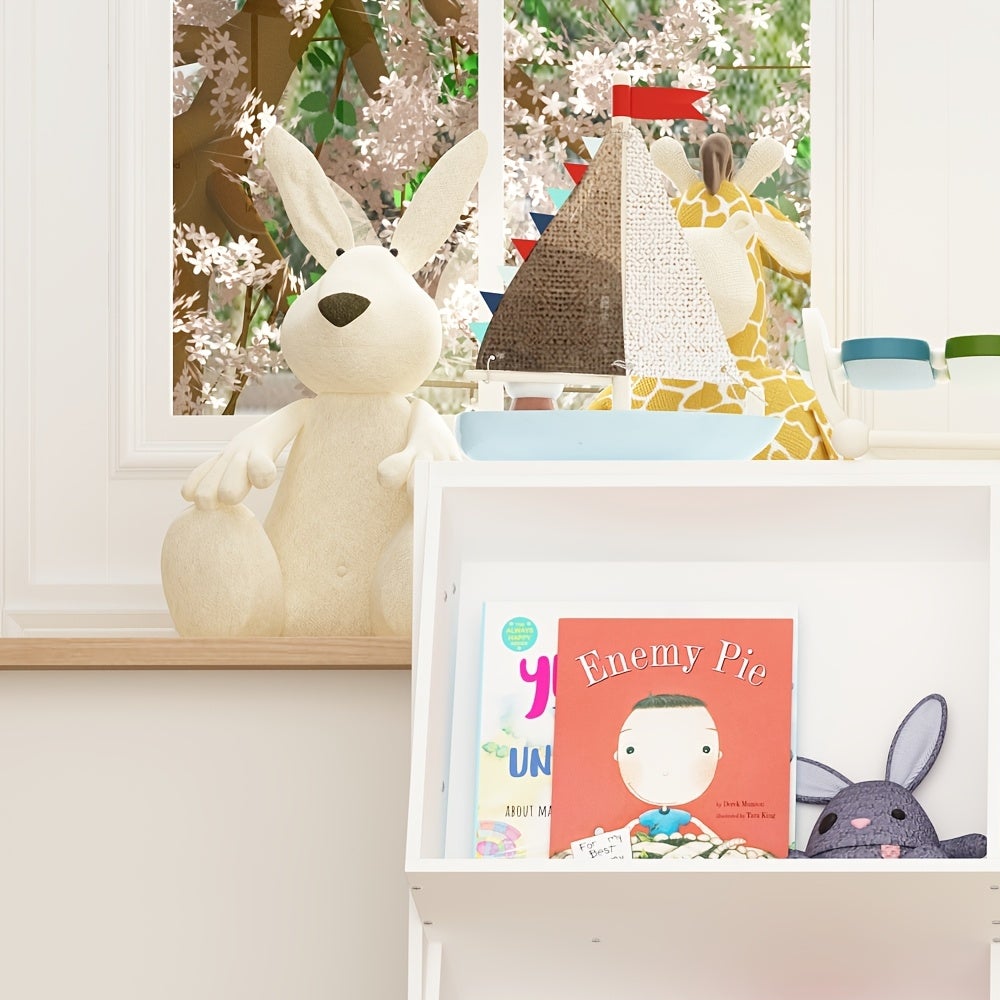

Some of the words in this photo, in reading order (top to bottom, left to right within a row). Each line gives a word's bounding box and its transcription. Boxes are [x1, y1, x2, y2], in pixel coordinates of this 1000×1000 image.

[575, 643, 704, 687] Enemy
[712, 639, 767, 686] Pie
[509, 744, 552, 778] UN
[505, 805, 534, 818] ABOUT
